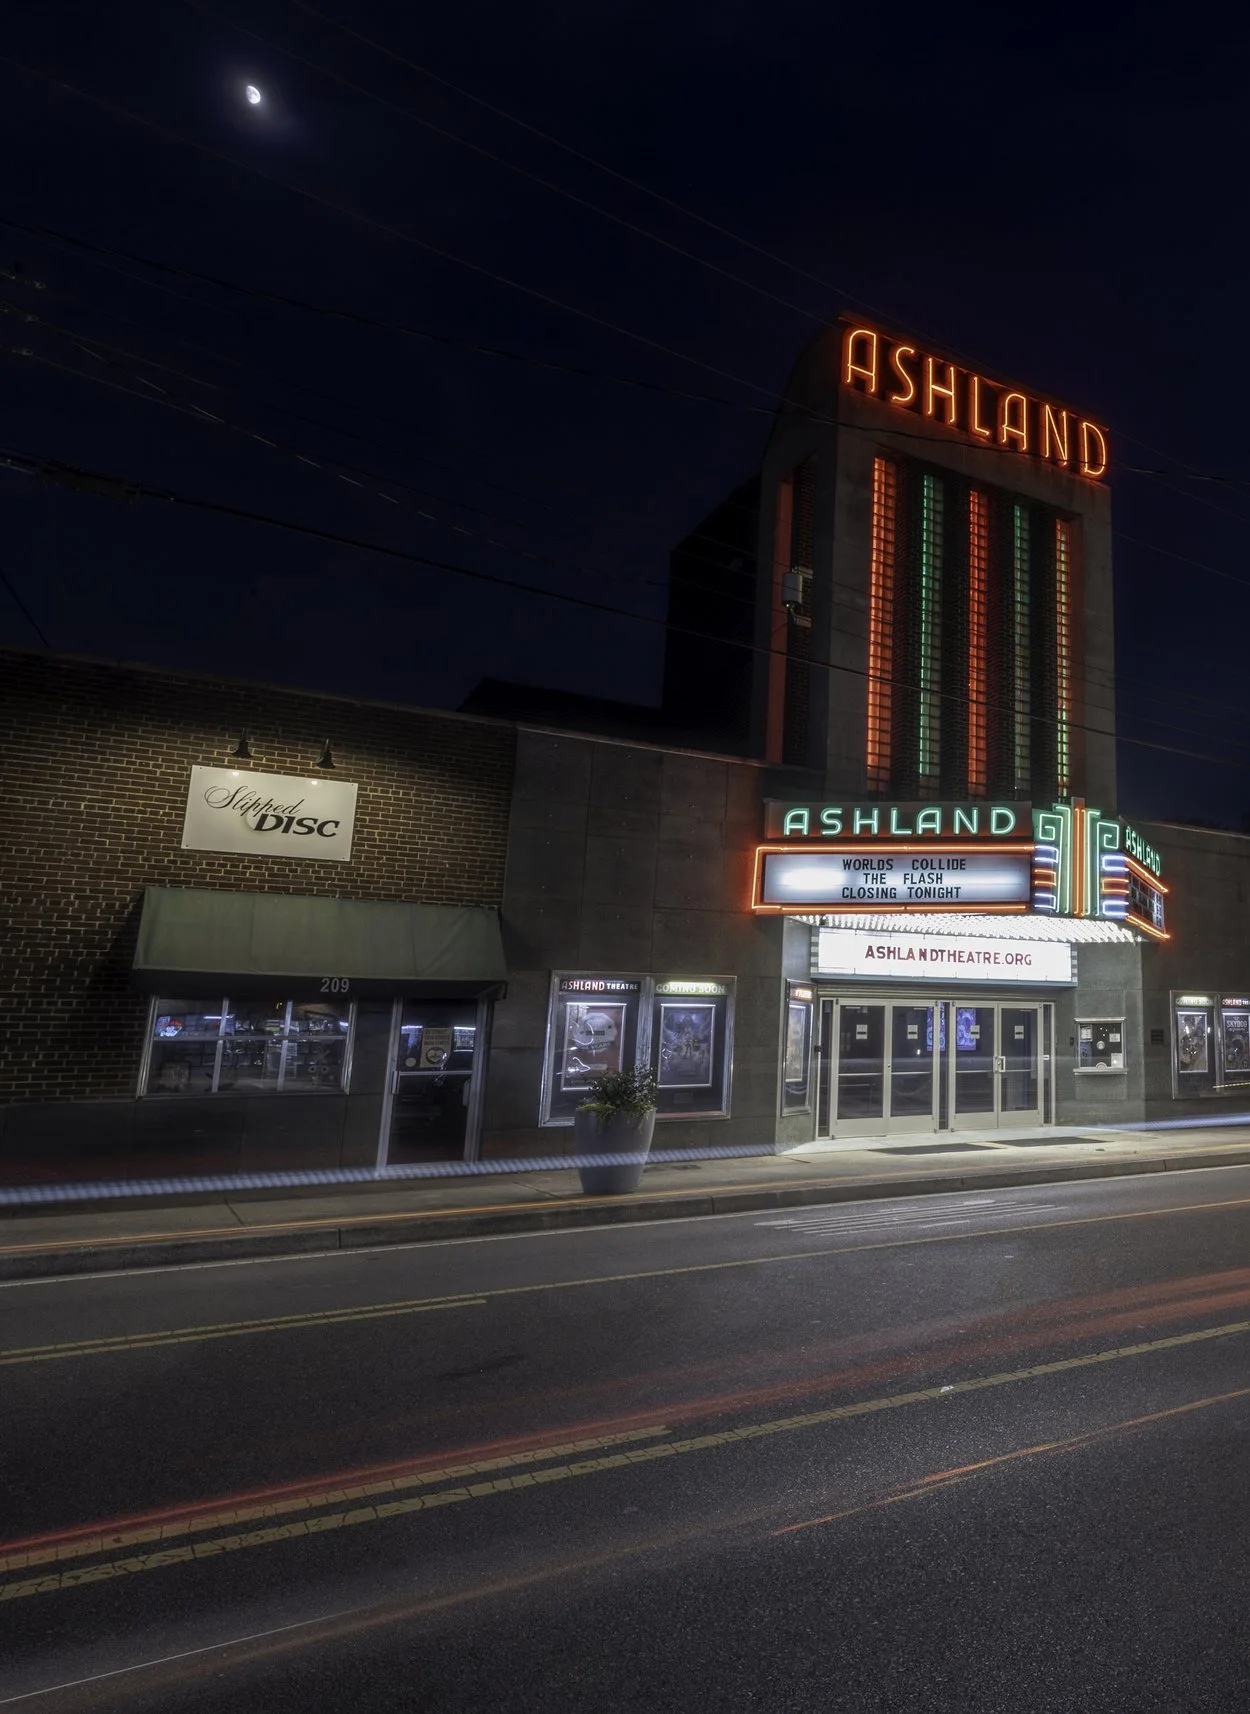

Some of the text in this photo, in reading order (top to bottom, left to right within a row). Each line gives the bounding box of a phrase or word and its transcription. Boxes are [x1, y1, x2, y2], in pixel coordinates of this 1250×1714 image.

[845, 328, 1109, 477] ASHLAND
[204, 785, 305, 818] Slipped
[253, 813, 341, 838] DISC
[783, 807, 1018, 837] ASHLAND
[1125, 825, 1161, 878] ASHLAND
[842, 858, 967, 871] WORLDS COLLIDE
[863, 872, 943, 885] THE FLASH
[841, 886, 962, 899] CLOSING TONIGHT
[865, 944, 1033, 966] ASHLANDTHEATRE.ORG
[320, 977, 350, 993] 209
[561, 980, 639, 991] ASHLAND THEATRE
[655, 983, 726, 994] COMING SOON
